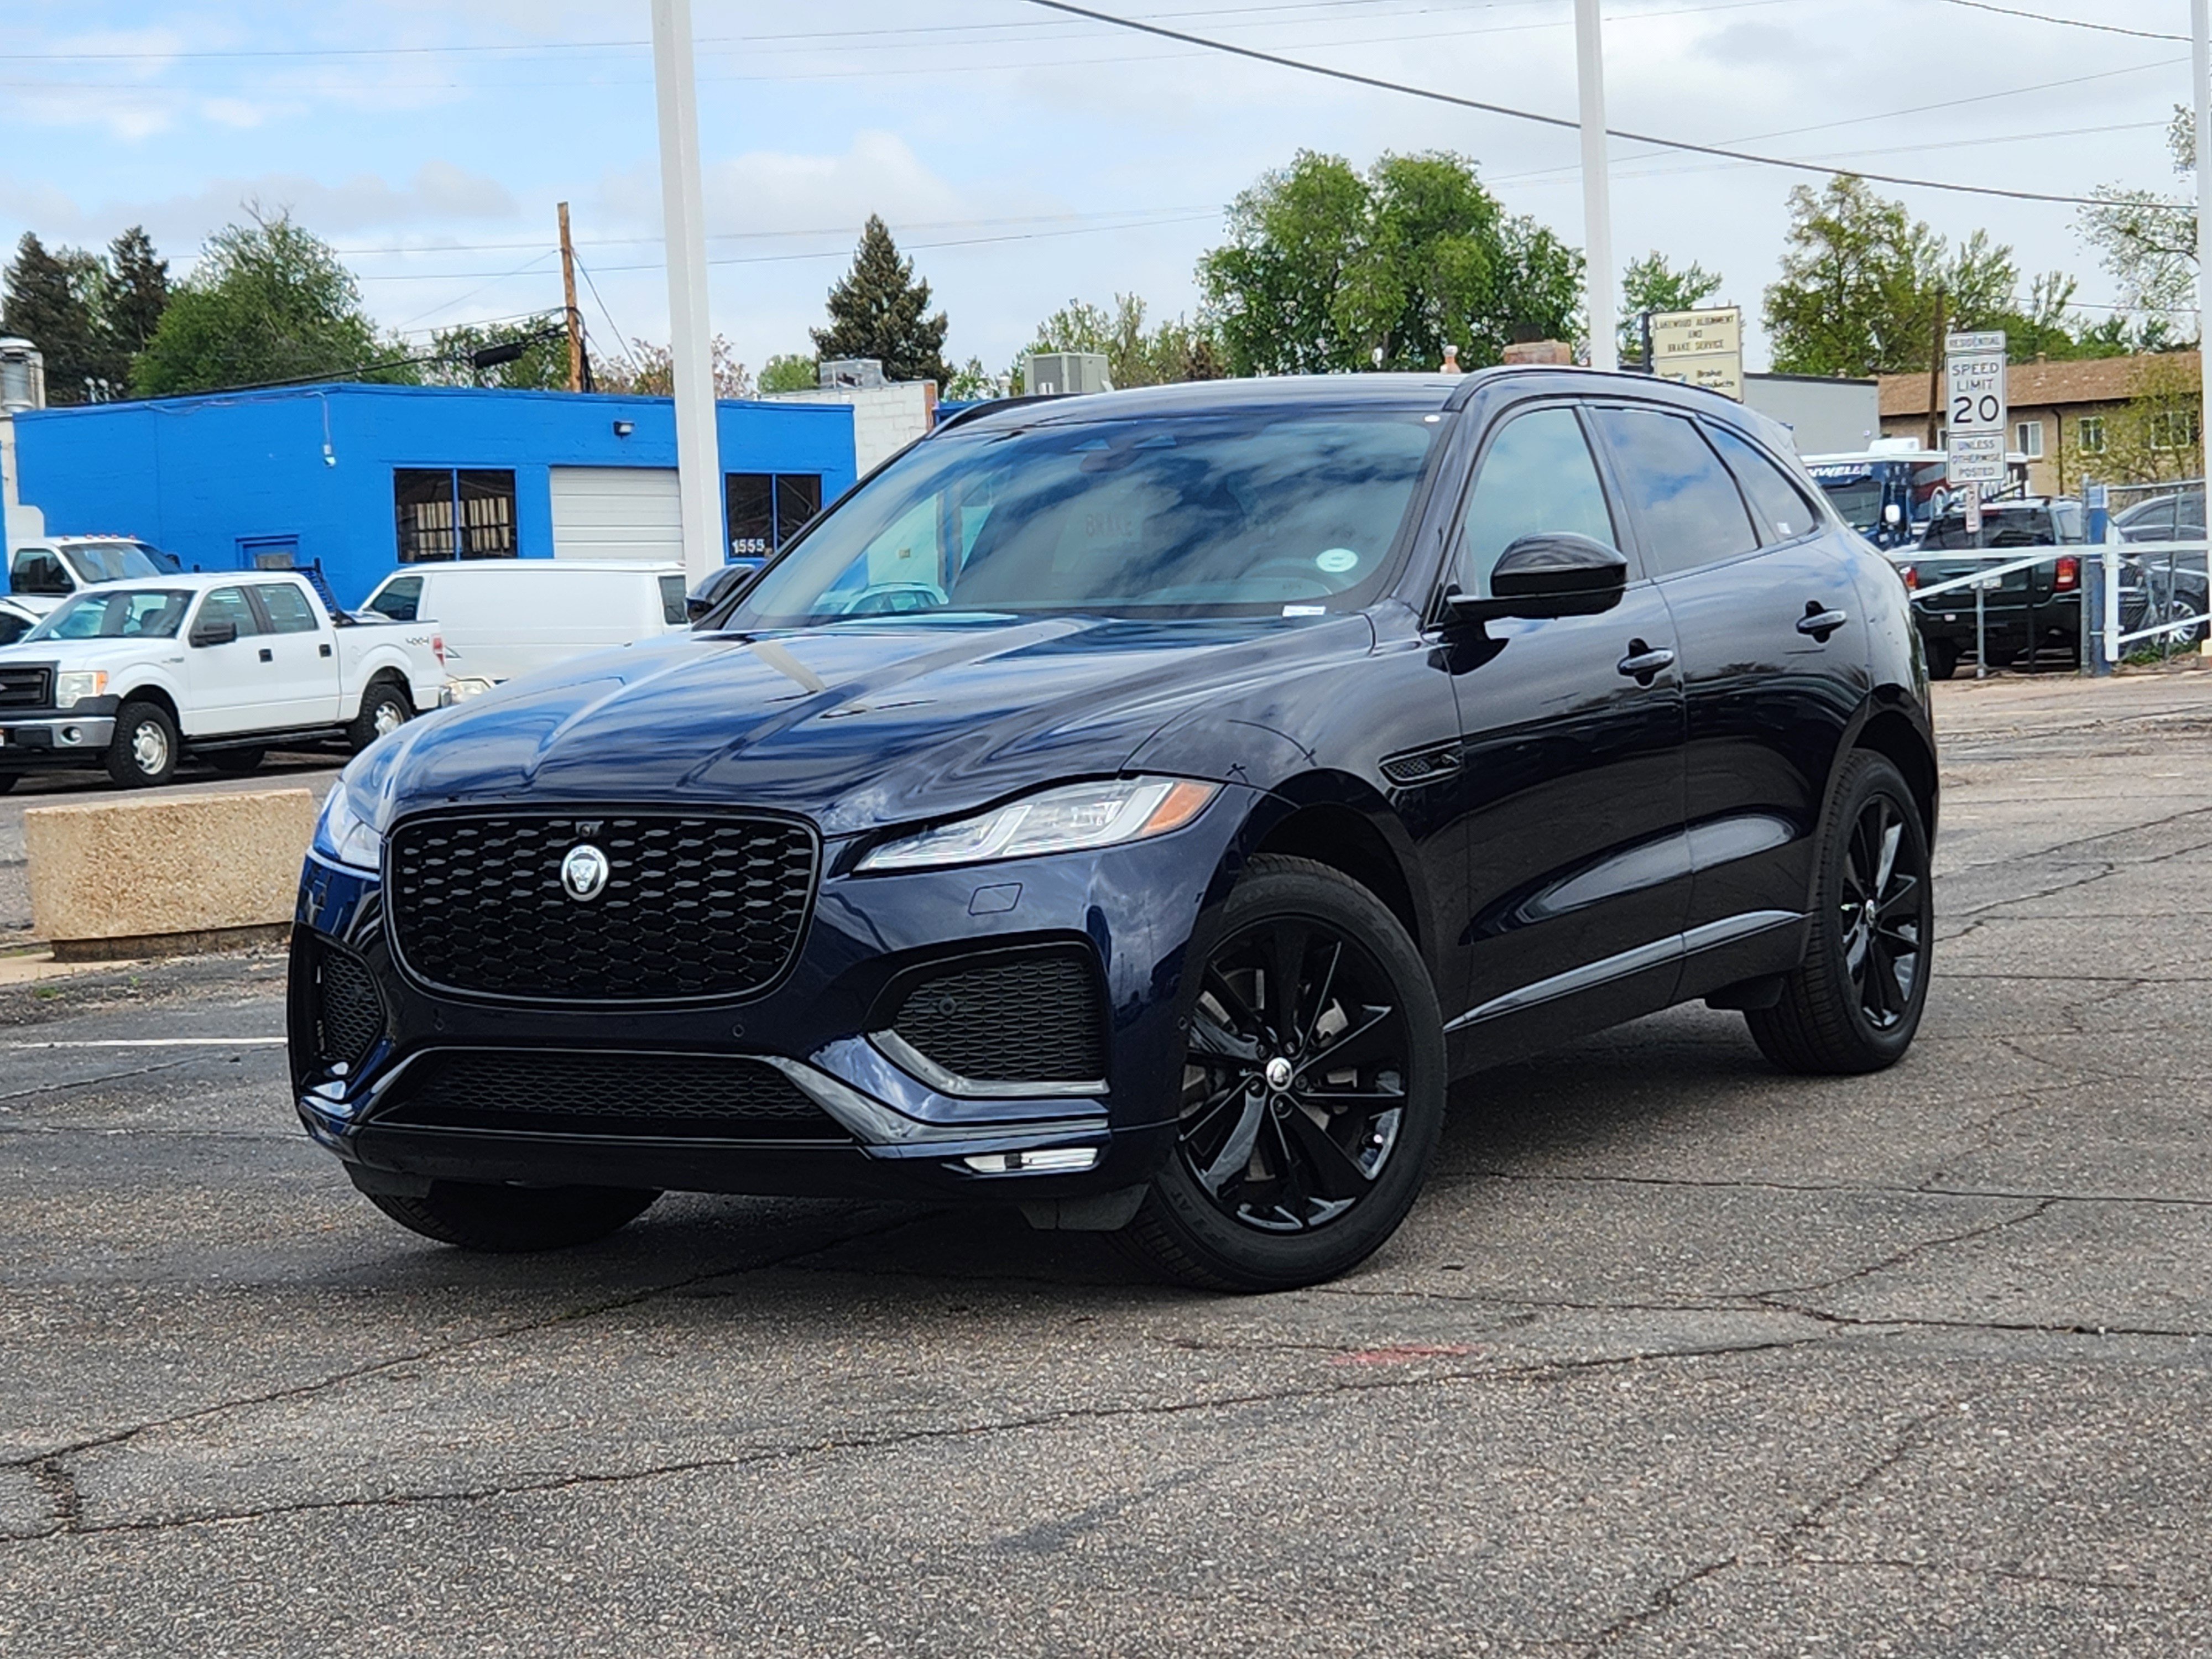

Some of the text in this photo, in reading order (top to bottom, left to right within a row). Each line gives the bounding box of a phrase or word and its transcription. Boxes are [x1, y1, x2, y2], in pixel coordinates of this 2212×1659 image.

[1695, 315, 1734, 326] ALIGNMENT
[1688, 330, 1702, 338] AND
[1667, 339, 1724, 352] BRAKE SERVICE
[1949, 336, 2000, 348] RESIDENTIAL
[1952, 362, 1999, 377] SPEED
[1957, 379, 1994, 392] LIMIT
[1953, 394, 2000, 424] 20
[1958, 440, 1995, 451] UNLESS
[1952, 453, 2001, 465] OTHERWISE
[1958, 467, 1995, 477] POSTED
[732, 538, 765, 554] 1555
